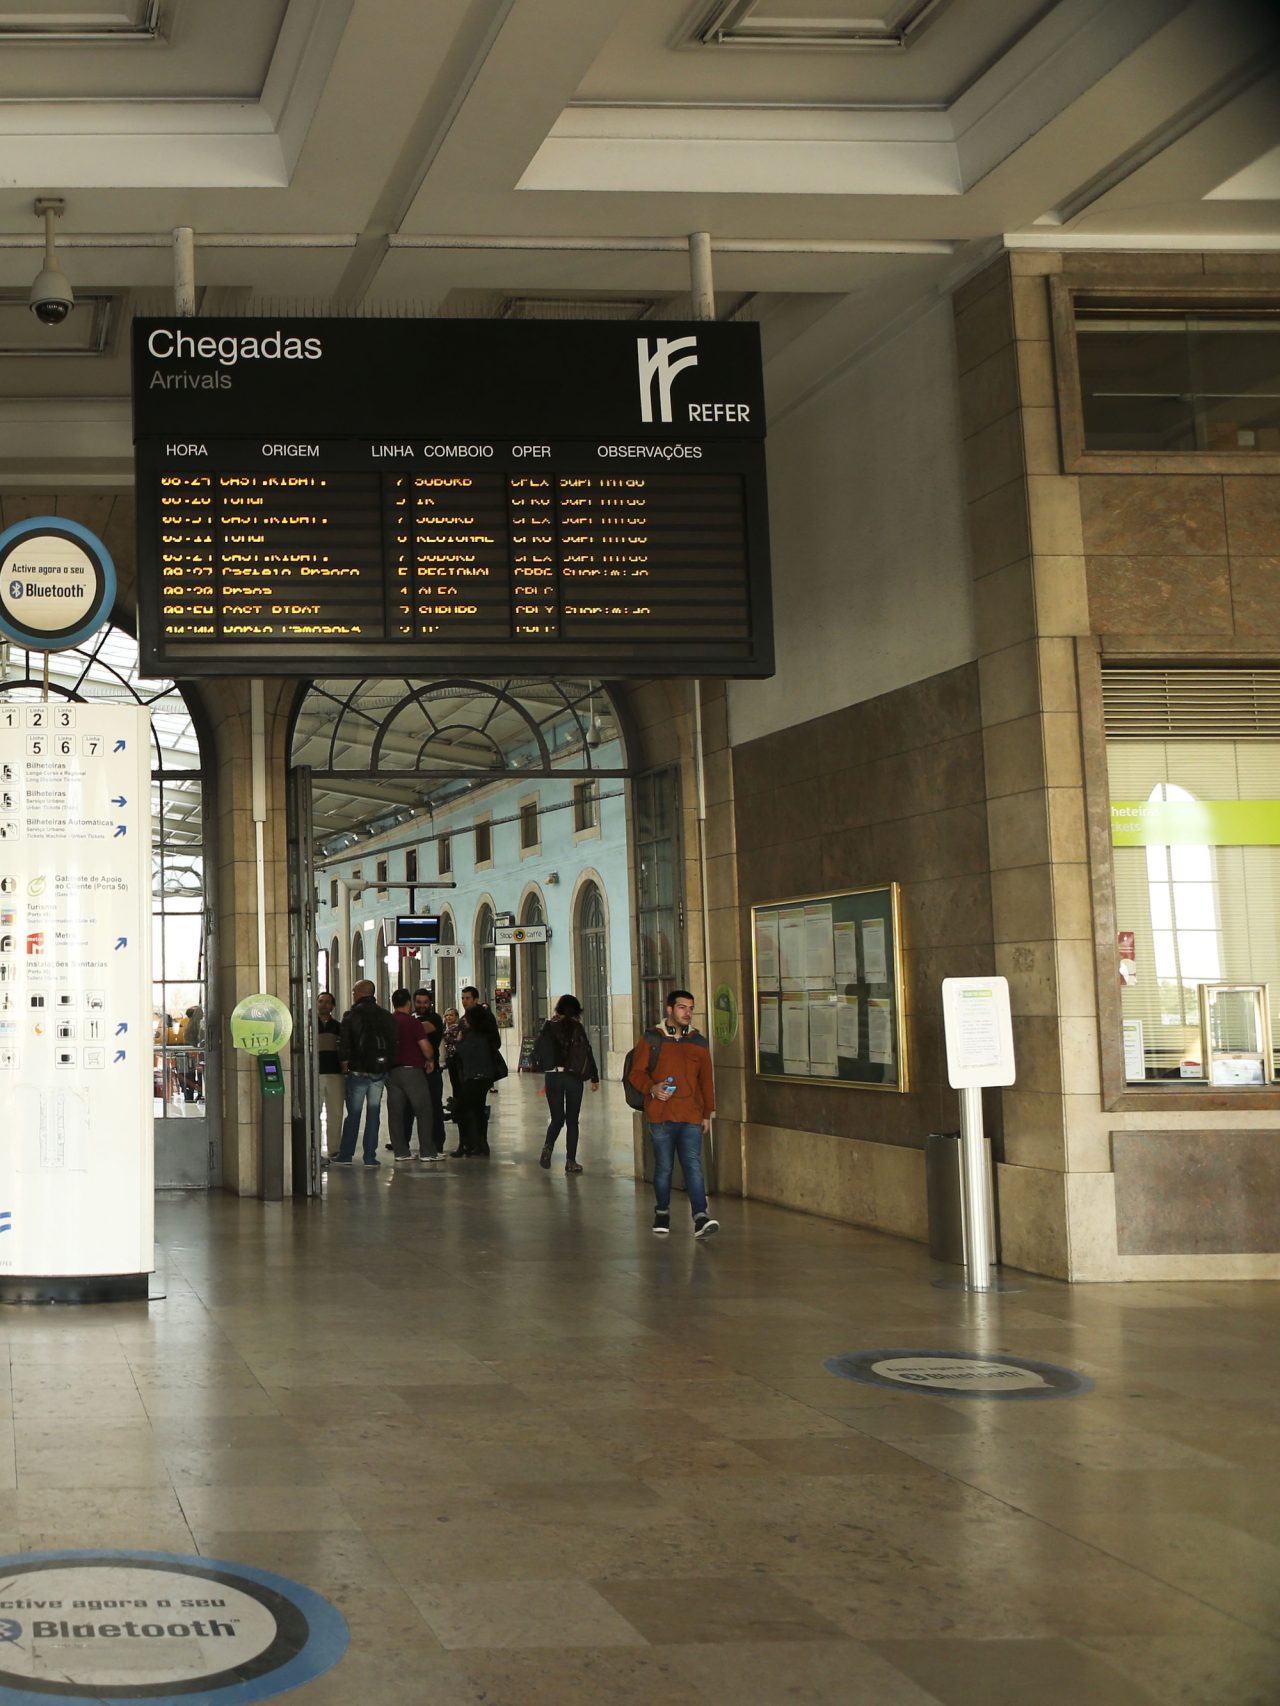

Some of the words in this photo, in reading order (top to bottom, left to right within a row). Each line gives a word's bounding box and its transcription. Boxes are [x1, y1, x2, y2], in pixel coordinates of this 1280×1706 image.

[147, 329, 322, 366] Chegadas
[149, 370, 232, 391] Arrivals
[688, 403, 751, 422] REFER
[166, 444, 208, 457] HORA
[262, 444, 319, 457] ORIGEM
[371, 445, 414, 458] LINHA
[424, 444, 494, 458] COMBOIO
[512, 445, 551, 458] OPER
[597, 443, 703, 461] OBSERVAÇÕES
[11, 563, 36, 573] Active
[38, 565, 61, 575] agora
[63, 566, 68, 574] o
[70, 566, 84, 574] seu
[26, 583, 85, 598] Bluetooth
[6, 714, 12, 727] 1
[32, 713, 42, 726] 2
[61, 713, 70, 726] 3
[32, 741, 41, 754] 5
[61, 741, 70, 754] 6
[89, 743, 97, 755] 7
[100, 875, 122, 884] Apoio
[117, 883, 128, 891] 50)
[499, 932, 512, 940] Stop
[72, 1598, 149, 1611] agora
[157, 1598, 173, 1608] o
[180, 1598, 226, 1608] seu
[32, 1618, 236, 1638] Bluetooth
